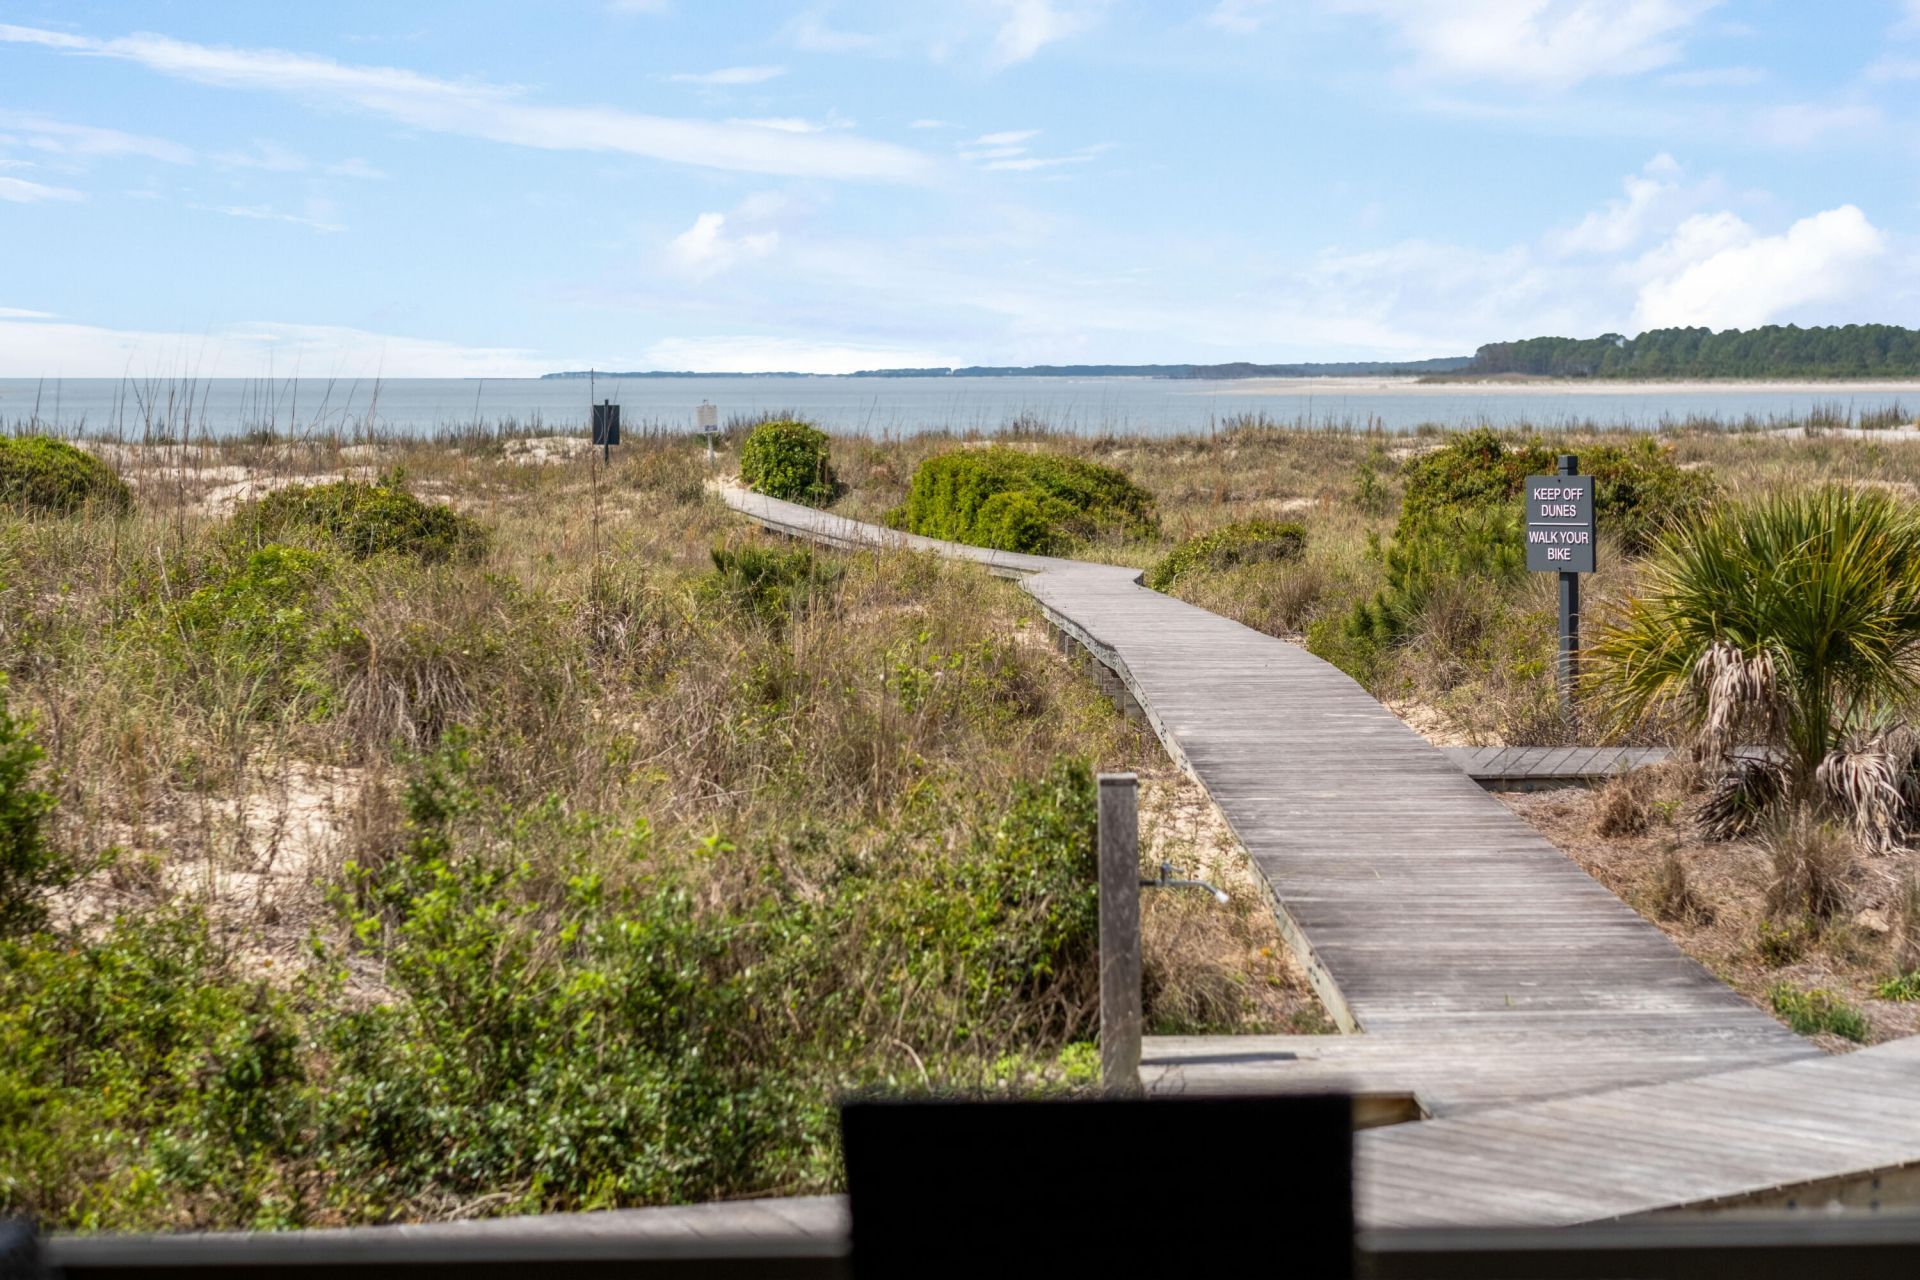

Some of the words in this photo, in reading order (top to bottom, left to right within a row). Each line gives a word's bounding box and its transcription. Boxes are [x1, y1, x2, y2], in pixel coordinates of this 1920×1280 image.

[1533, 487, 1561, 500] KEEP
[1563, 488, 1584, 500] OFF
[1541, 504, 1577, 517] DUNES
[1529, 531, 1558, 544] WALK
[1560, 531, 1589, 544] YOUR
[1547, 547, 1571, 560] BIKE
